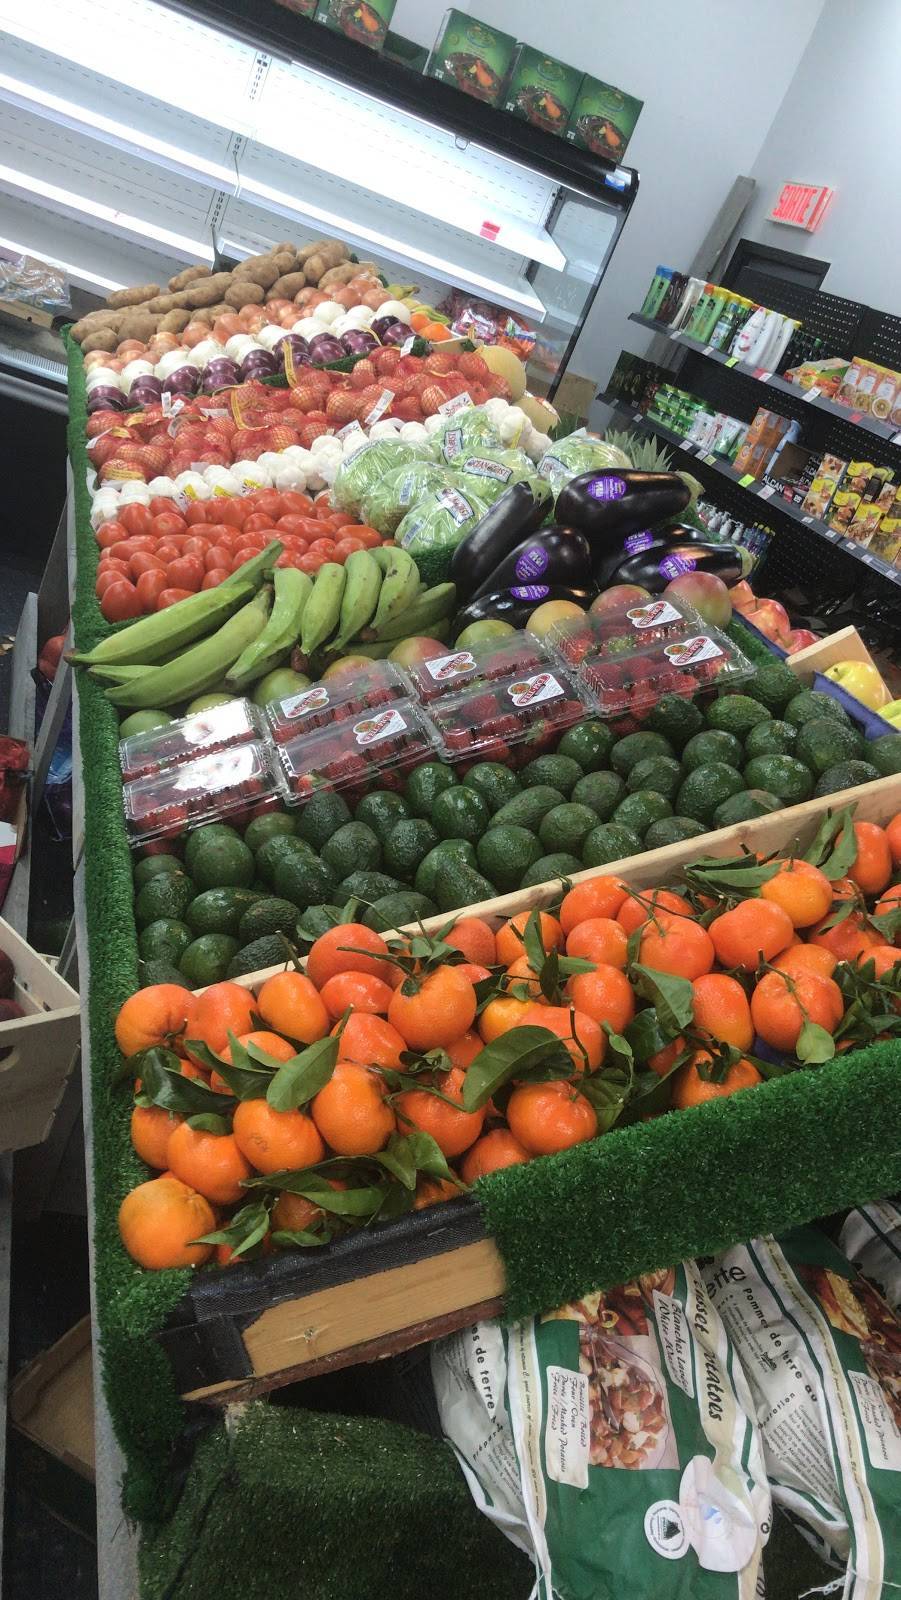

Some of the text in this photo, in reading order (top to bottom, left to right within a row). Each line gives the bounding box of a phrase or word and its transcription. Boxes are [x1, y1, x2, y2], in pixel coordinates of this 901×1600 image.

[762, 475, 785, 493] ALCAN
[769, 1332, 782, 1348] de
[475, 1347, 486, 1364] de
[480, 1369, 495, 1410] terre
